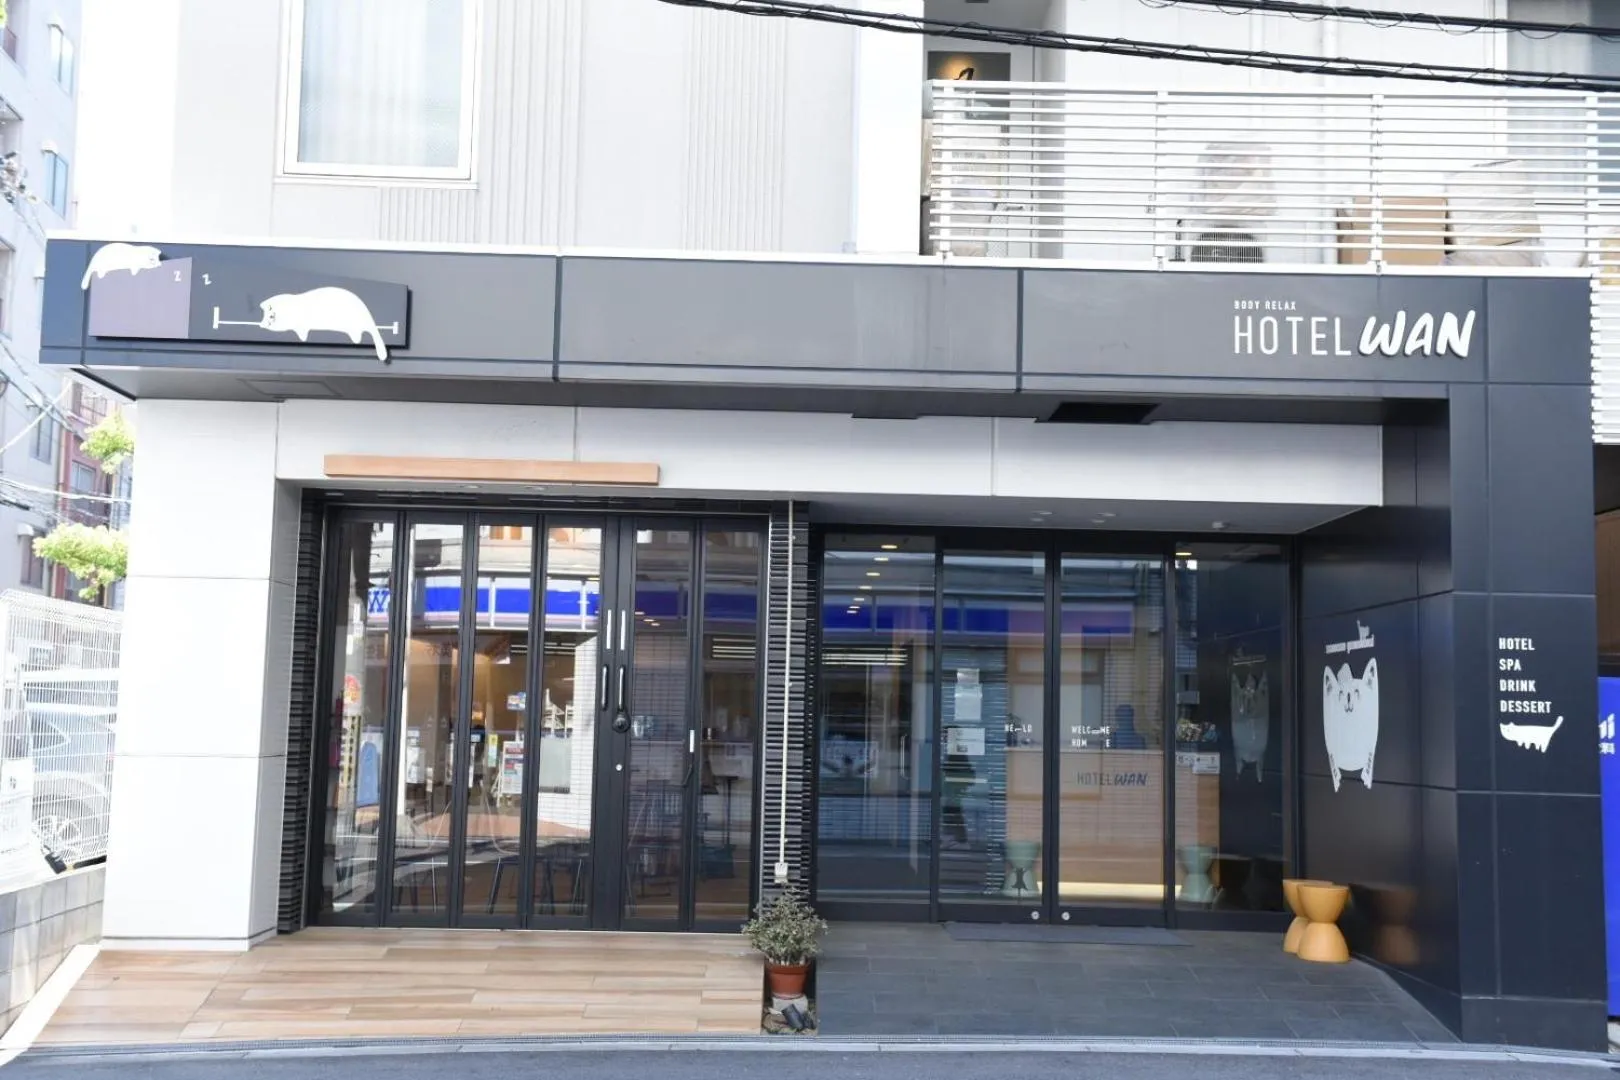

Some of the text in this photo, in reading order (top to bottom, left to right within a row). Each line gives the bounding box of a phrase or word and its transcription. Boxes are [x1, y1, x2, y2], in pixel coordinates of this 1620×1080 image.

[1234, 299, 1297, 311] BODY RELAX
[1234, 309, 1476, 358] HOTEL WAN
[1499, 637, 1535, 651] HOTEL
[1499, 658, 1522, 671] SPA
[1500, 680, 1537, 692] DRINK
[1500, 700, 1552, 713] DESSERT
[1077, 771, 1148, 787] HOTEL WAN
